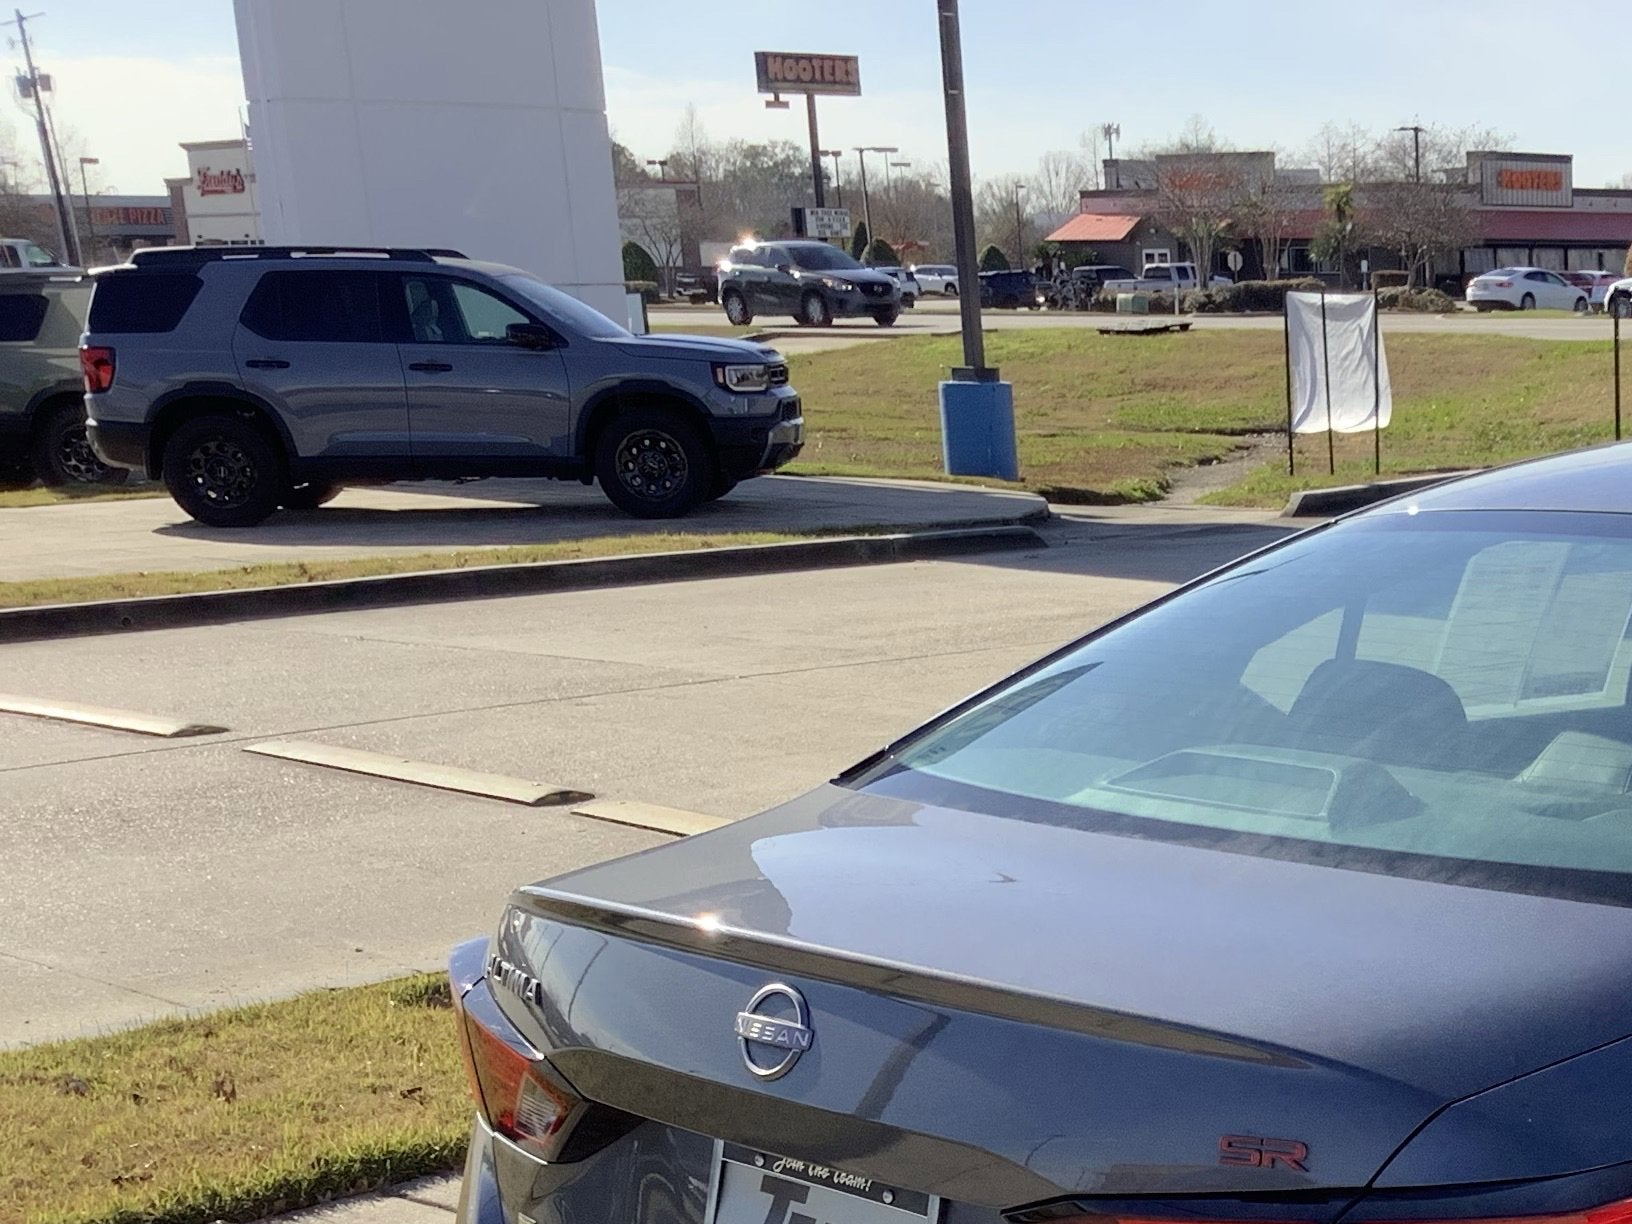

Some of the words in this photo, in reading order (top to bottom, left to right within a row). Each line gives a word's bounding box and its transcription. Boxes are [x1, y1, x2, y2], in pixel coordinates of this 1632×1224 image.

[766, 55, 857, 83] HOOTERS
[129, 206, 166, 225] PIZZA
[736, 1017, 810, 1047] NISSAN
[1218, 1134, 1309, 1172] SR
